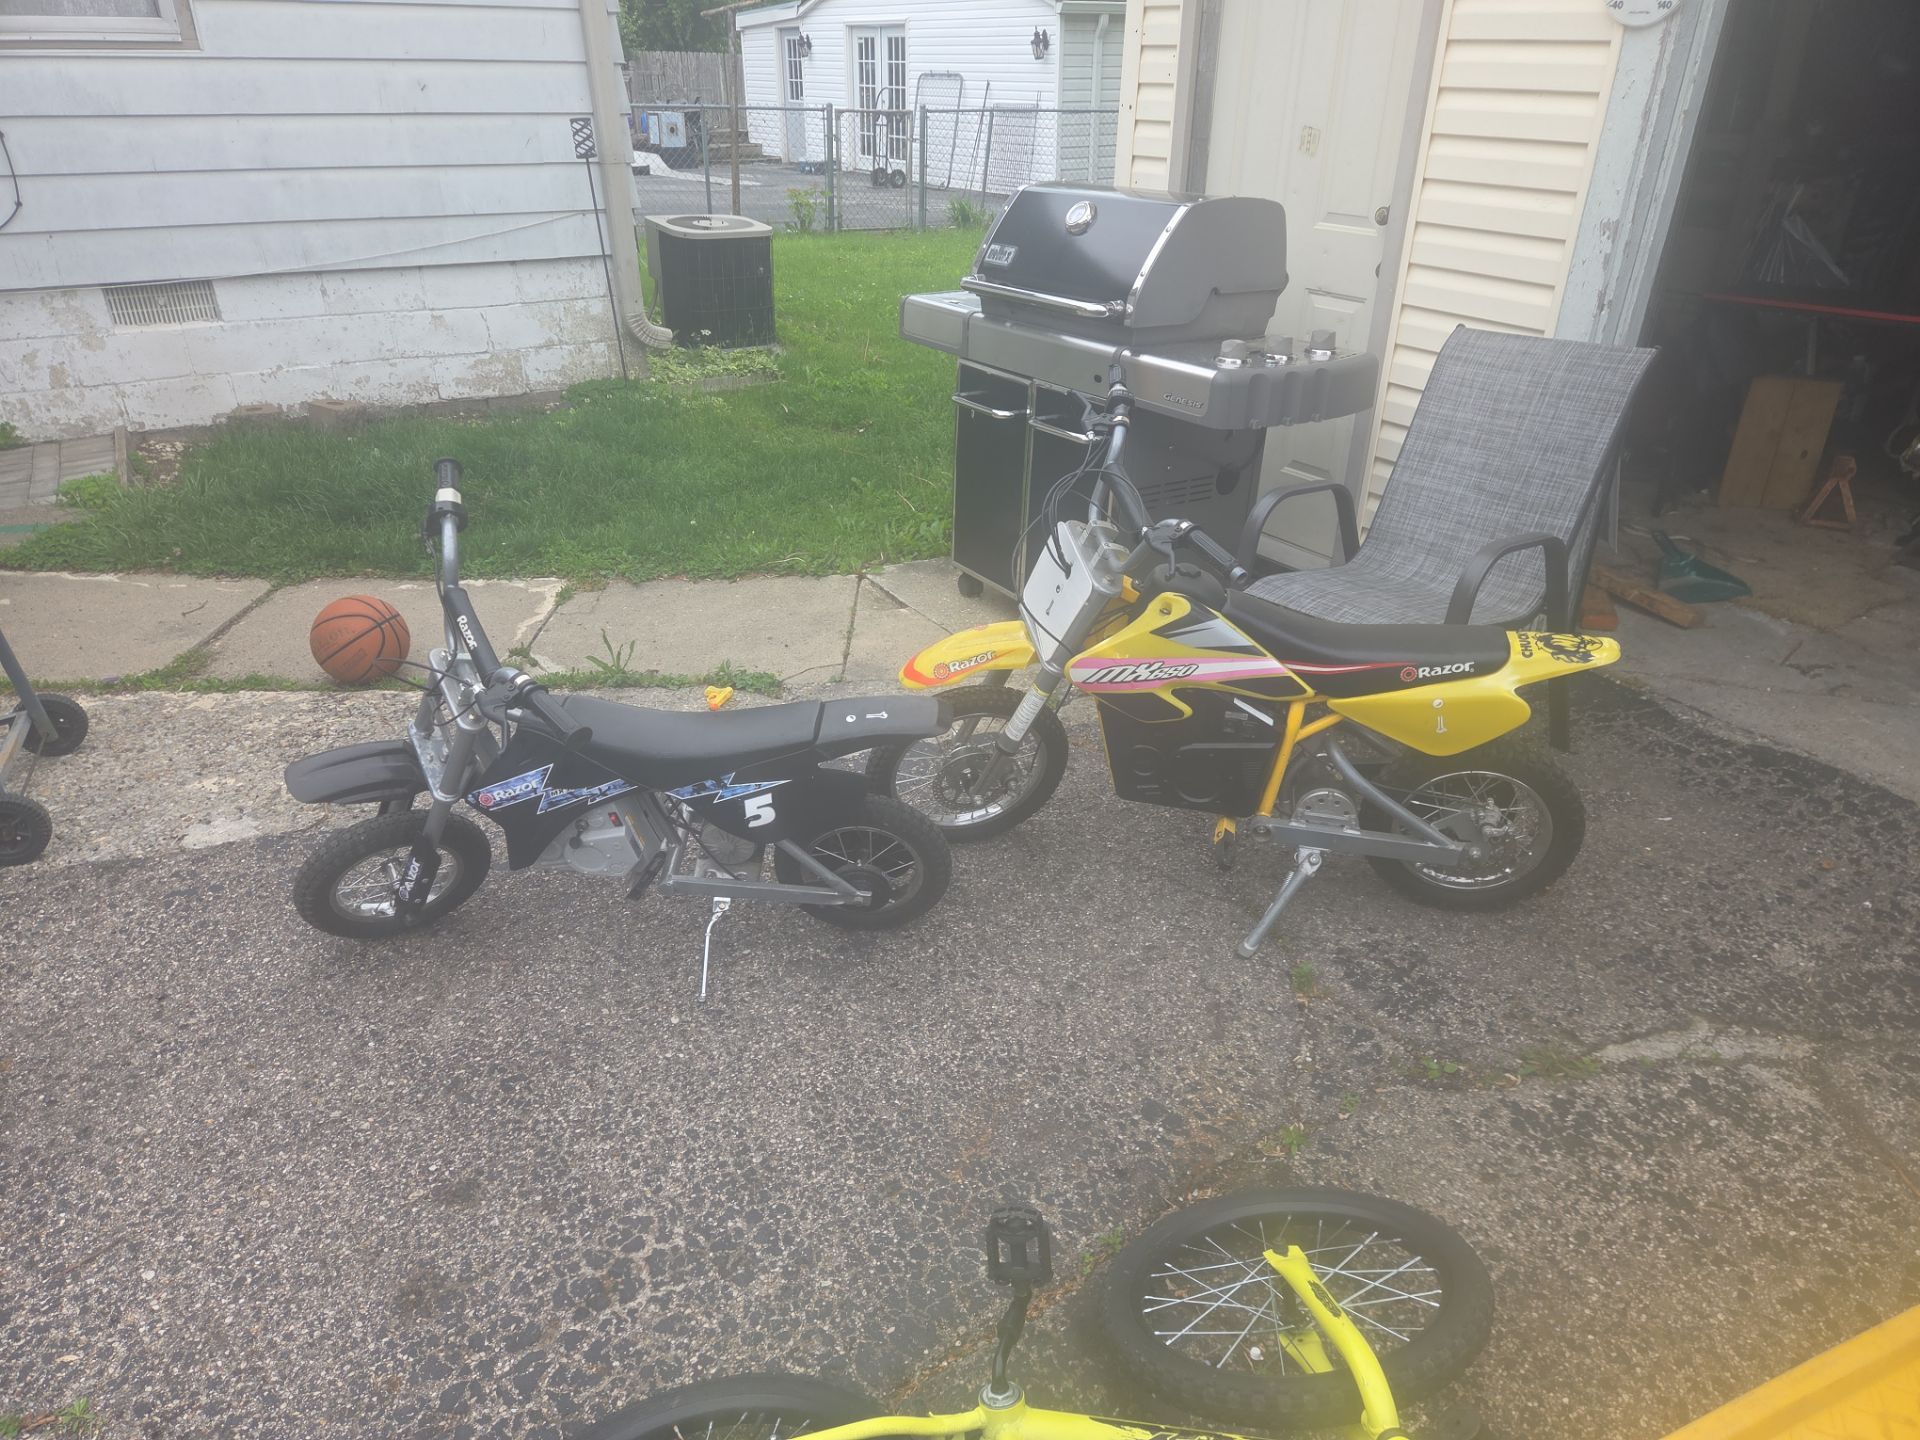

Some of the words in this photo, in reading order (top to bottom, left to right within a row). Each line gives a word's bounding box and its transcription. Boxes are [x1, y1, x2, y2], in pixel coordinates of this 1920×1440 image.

[456, 615, 478, 650] Razor
[948, 651, 994, 673] Razor
[1418, 661, 1475, 678] Razor
[493, 780, 541, 801] Razor
[744, 793, 776, 828] 5
